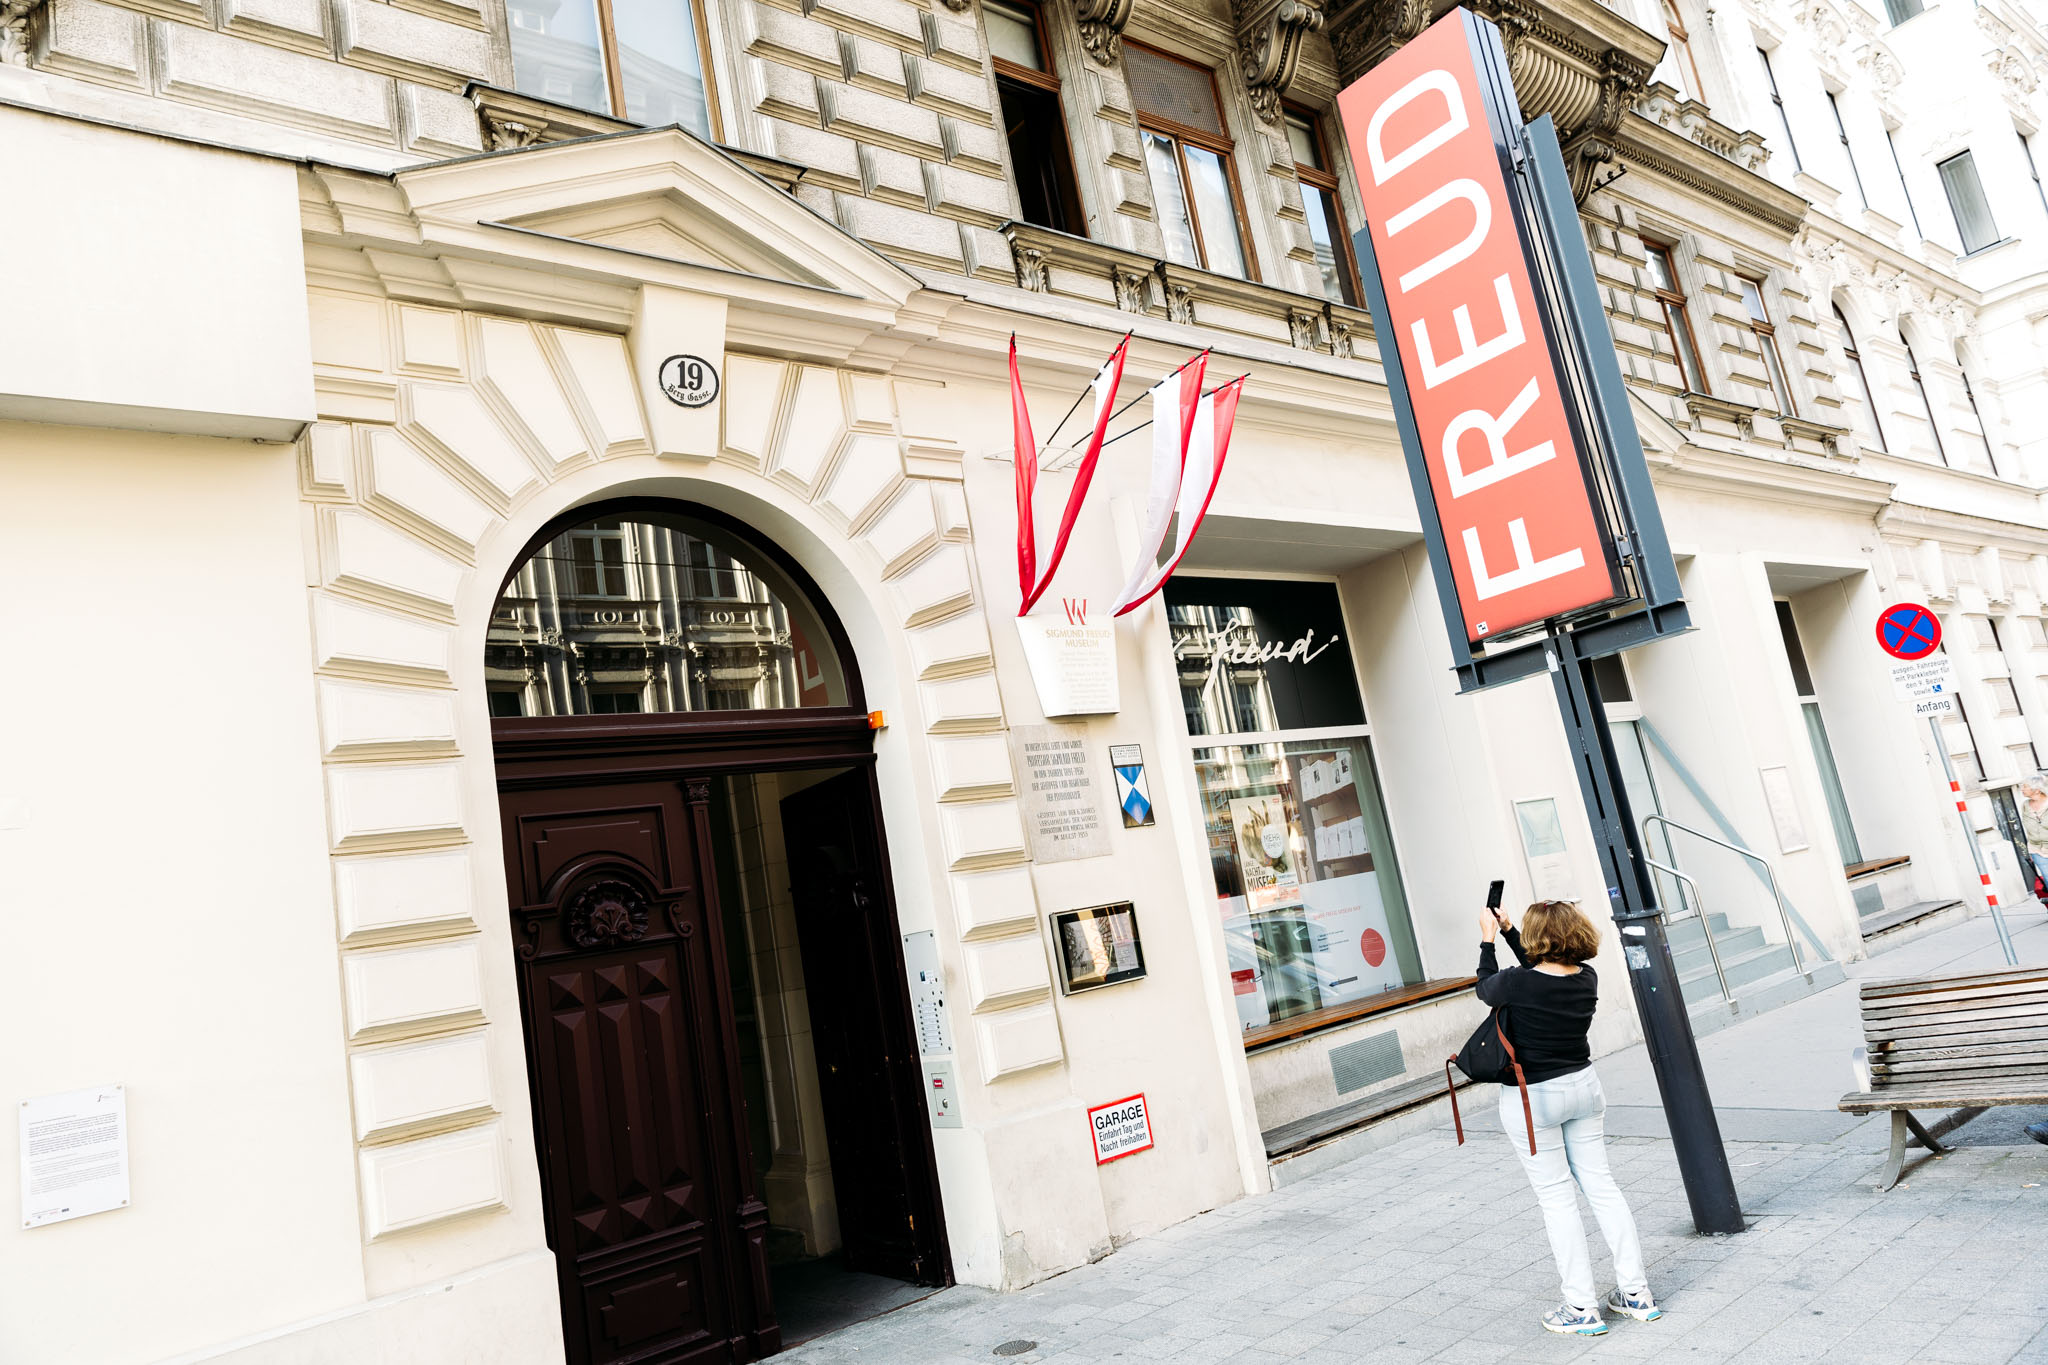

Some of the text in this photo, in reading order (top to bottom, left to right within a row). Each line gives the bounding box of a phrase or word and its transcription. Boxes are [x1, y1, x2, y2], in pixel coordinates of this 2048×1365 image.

[1366, 69, 1586, 601] FREUD
[678, 361, 703, 390] 19
[668, 383, 684, 400] Berg
[1046, 629, 1085, 639] SIGMUND
[1065, 639, 1099, 649] MUSEUM
[1917, 659, 1948, 670] Fahrzeuge
[1895, 667, 1950, 683] mit Parkkleber für
[1926, 677, 1944, 686] Bezirk
[1914, 688, 1931, 696] sowie
[1916, 700, 1950, 714] Anfang
[1096, 1105, 1143, 1129] GARAGE
[1099, 1120, 1143, 1141] Einfahrt Tag und
[1101, 1133, 1146, 1152] Nacht freihalten
